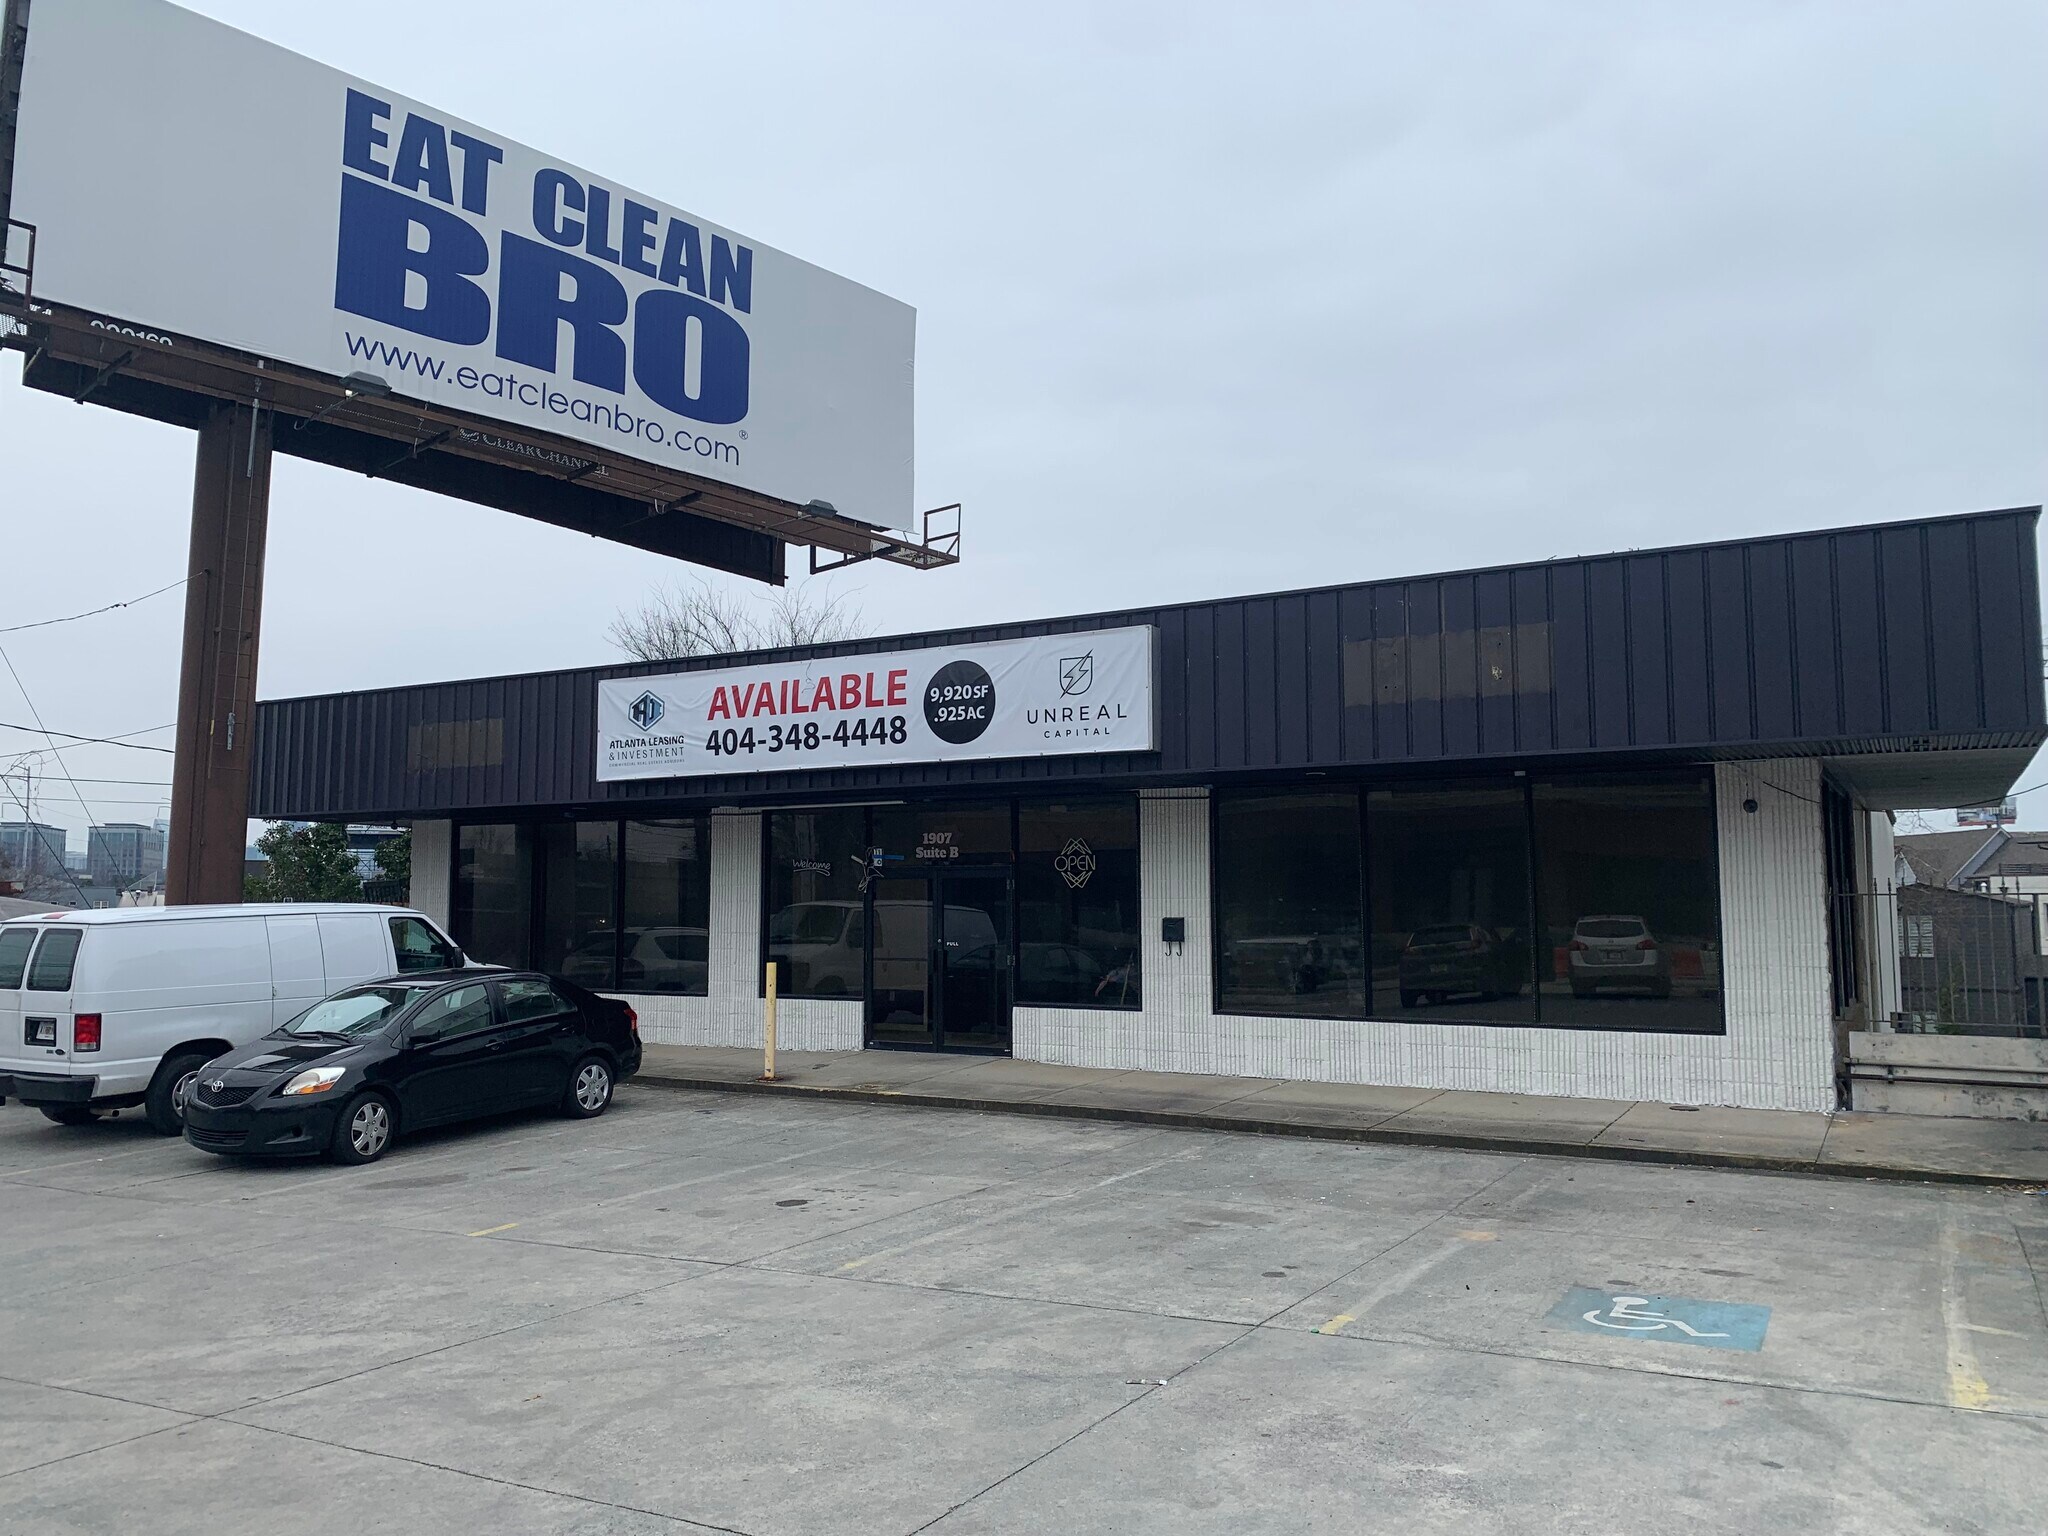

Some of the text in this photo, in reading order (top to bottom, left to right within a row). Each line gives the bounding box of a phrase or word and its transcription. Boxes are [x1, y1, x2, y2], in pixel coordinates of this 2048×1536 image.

[343, 87, 753, 314] EAT CLEAN
[334, 171, 751, 424] BRO
[345, 331, 740, 465] www.eatcleanbro.com
[707, 669, 908, 721] AVAILABLE
[1027, 703, 1128, 725] UNREAL
[705, 715, 907, 756] 404-348-4448
[1043, 727, 1110, 739] CAPITAL
[609, 735, 685, 750] ATLANTA LEASING
[608, 746, 685, 761] & INVESTMENT
[922, 832, 952, 845] 1907
[915, 846, 959, 859] Suite B
[792, 858, 831, 870] Welcome
[1054, 854, 1096, 871] OPEN
